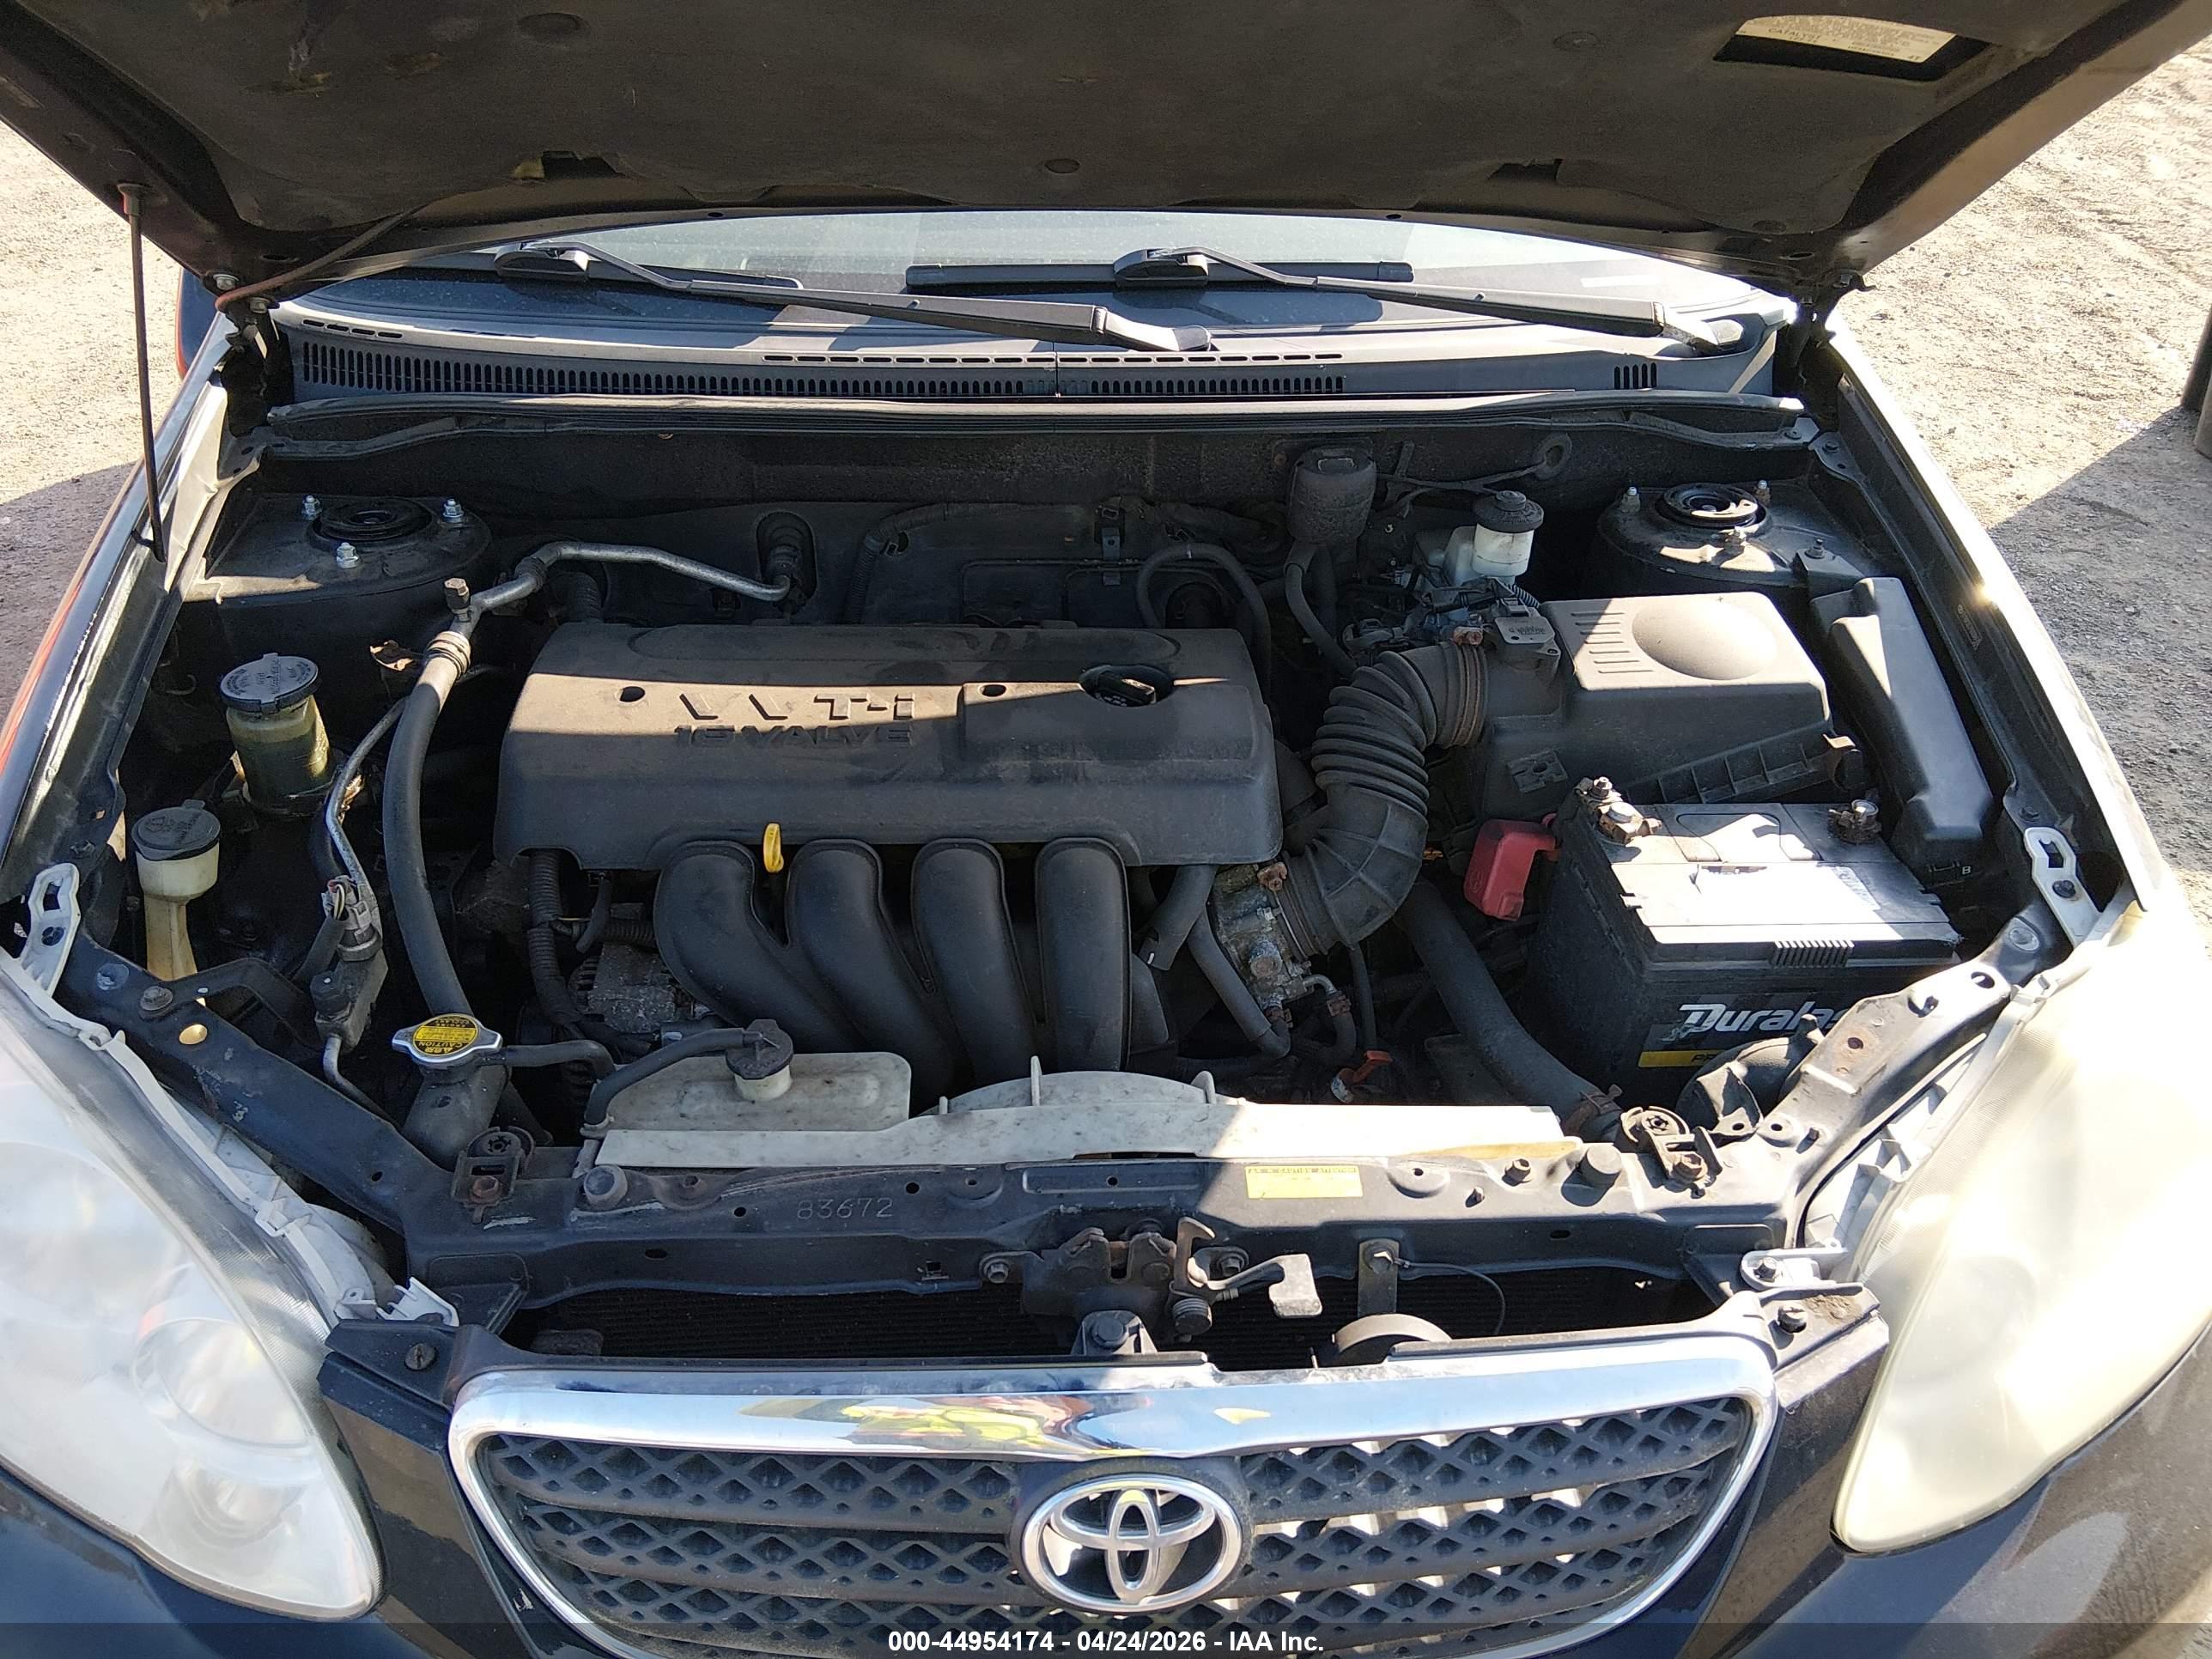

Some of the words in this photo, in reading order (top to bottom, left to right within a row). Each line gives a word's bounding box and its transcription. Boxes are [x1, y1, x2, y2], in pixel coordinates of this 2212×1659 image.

[673, 724, 736, 746] 16
[740, 724, 915, 747] VALVE
[1961, 866, 1972, 876] B
[796, 1197, 893, 1219] 83672
